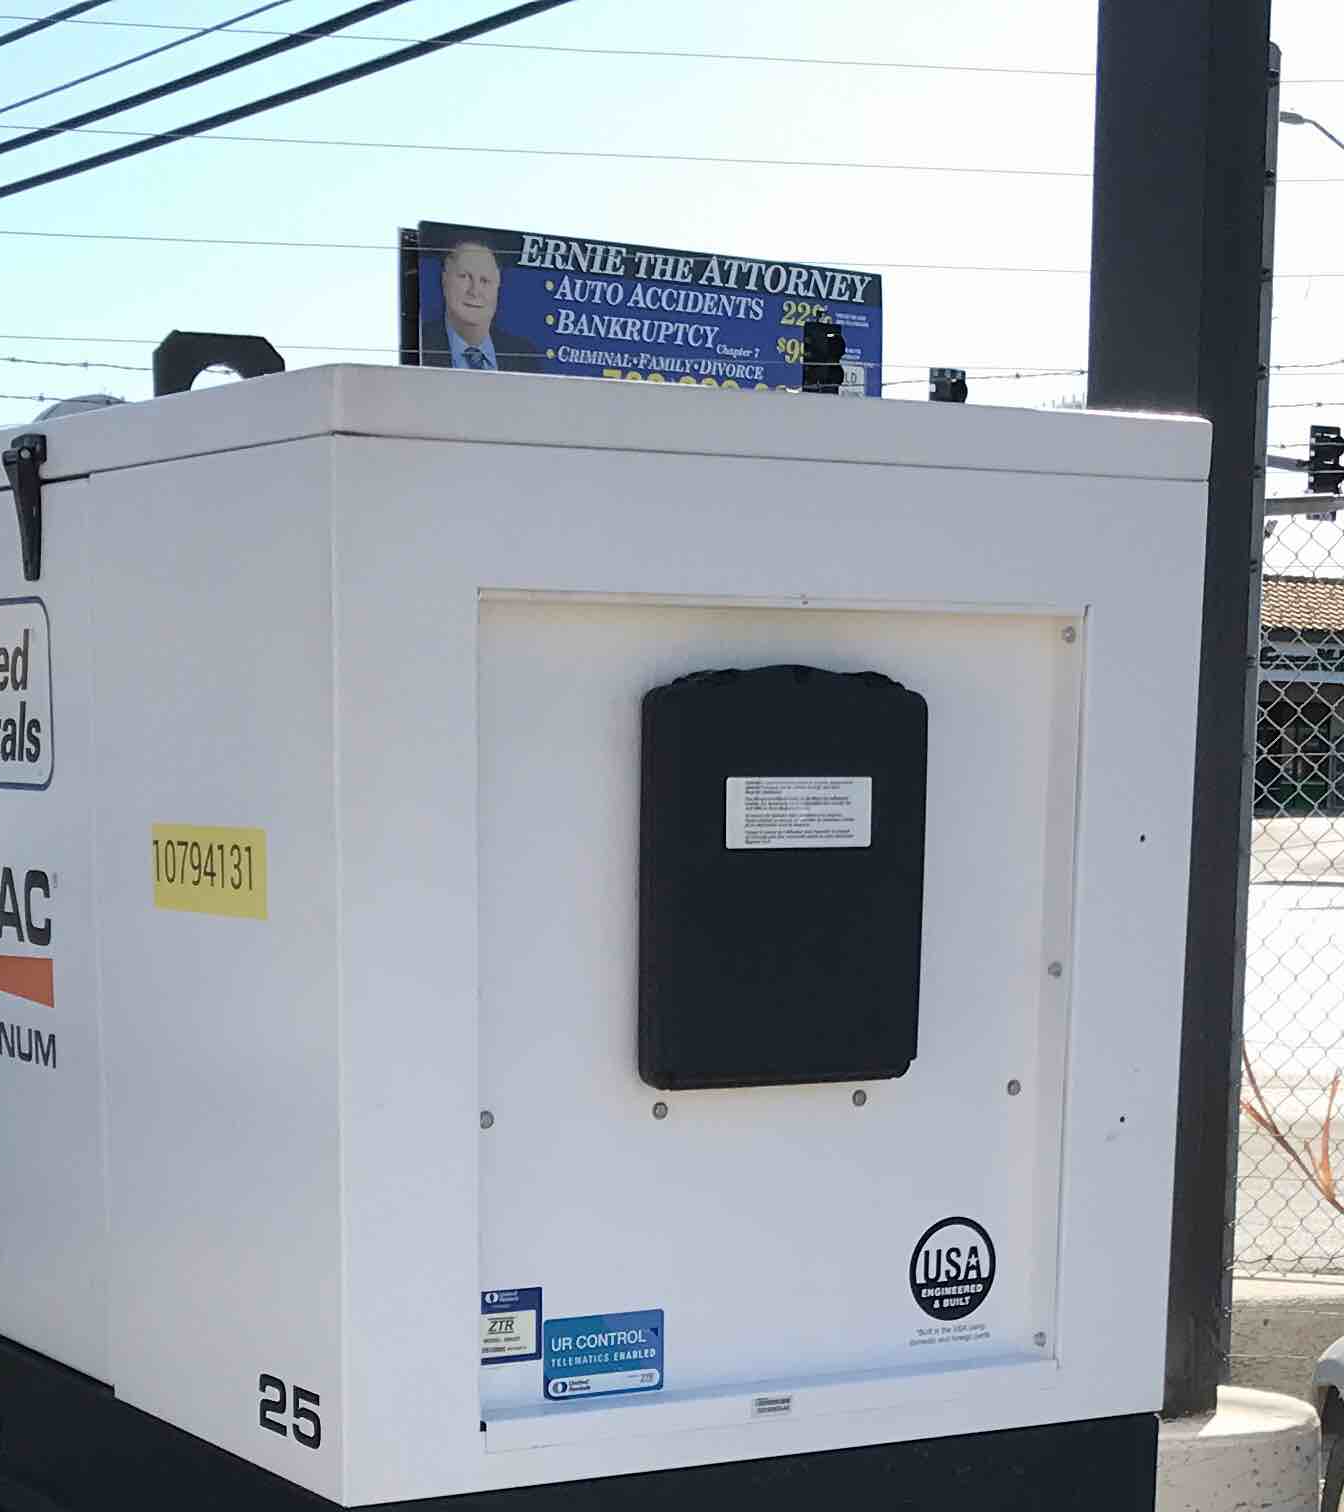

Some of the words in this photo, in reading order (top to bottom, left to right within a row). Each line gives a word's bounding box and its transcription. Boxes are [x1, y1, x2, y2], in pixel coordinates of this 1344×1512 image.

[518, 235, 626, 276] ERNIE
[635, 253, 694, 282] THE
[699, 256, 872, 302] ATTORNEY
[554, 276, 622, 305] AUTO
[628, 285, 765, 321] ACCIDENTS
[556, 309, 719, 348] BANKRUPTCY
[152, 839, 254, 890] 10794131
[923, 1245, 982, 1281] USA
[488, 1319, 515, 1333] ZTR
[550, 1335, 572, 1352] UR
[575, 1329, 647, 1350] CONTROL
[551, 1353, 610, 1368] TELEMATICS
[613, 1348, 657, 1361] ENABLED
[258, 1373, 322, 1450] 25
